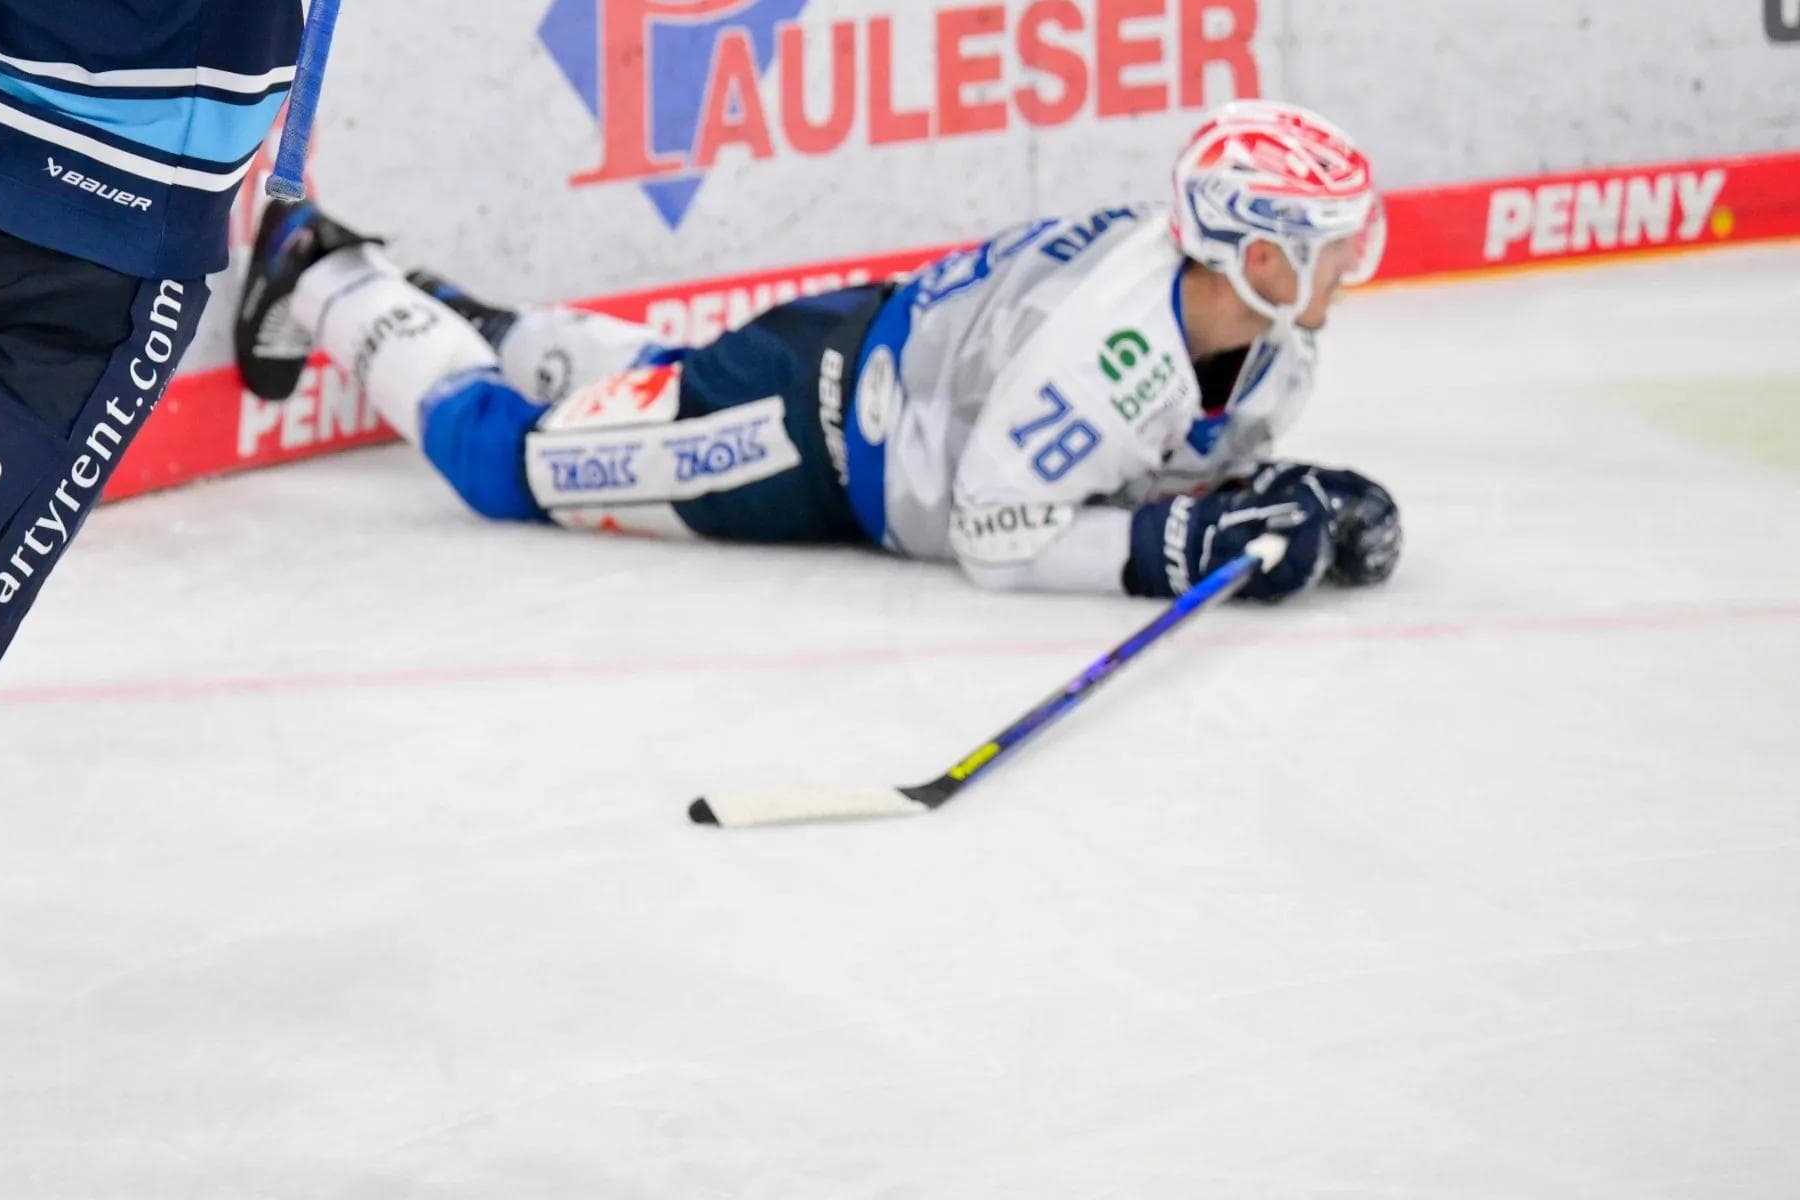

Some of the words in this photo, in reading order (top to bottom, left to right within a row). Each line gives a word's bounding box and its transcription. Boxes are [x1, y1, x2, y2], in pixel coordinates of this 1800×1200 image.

[62, 170, 152, 212] BAUER
[237, 366, 378, 460] PEN
[1009, 382, 1102, 482] 78
[1163, 494, 1196, 596] UER
